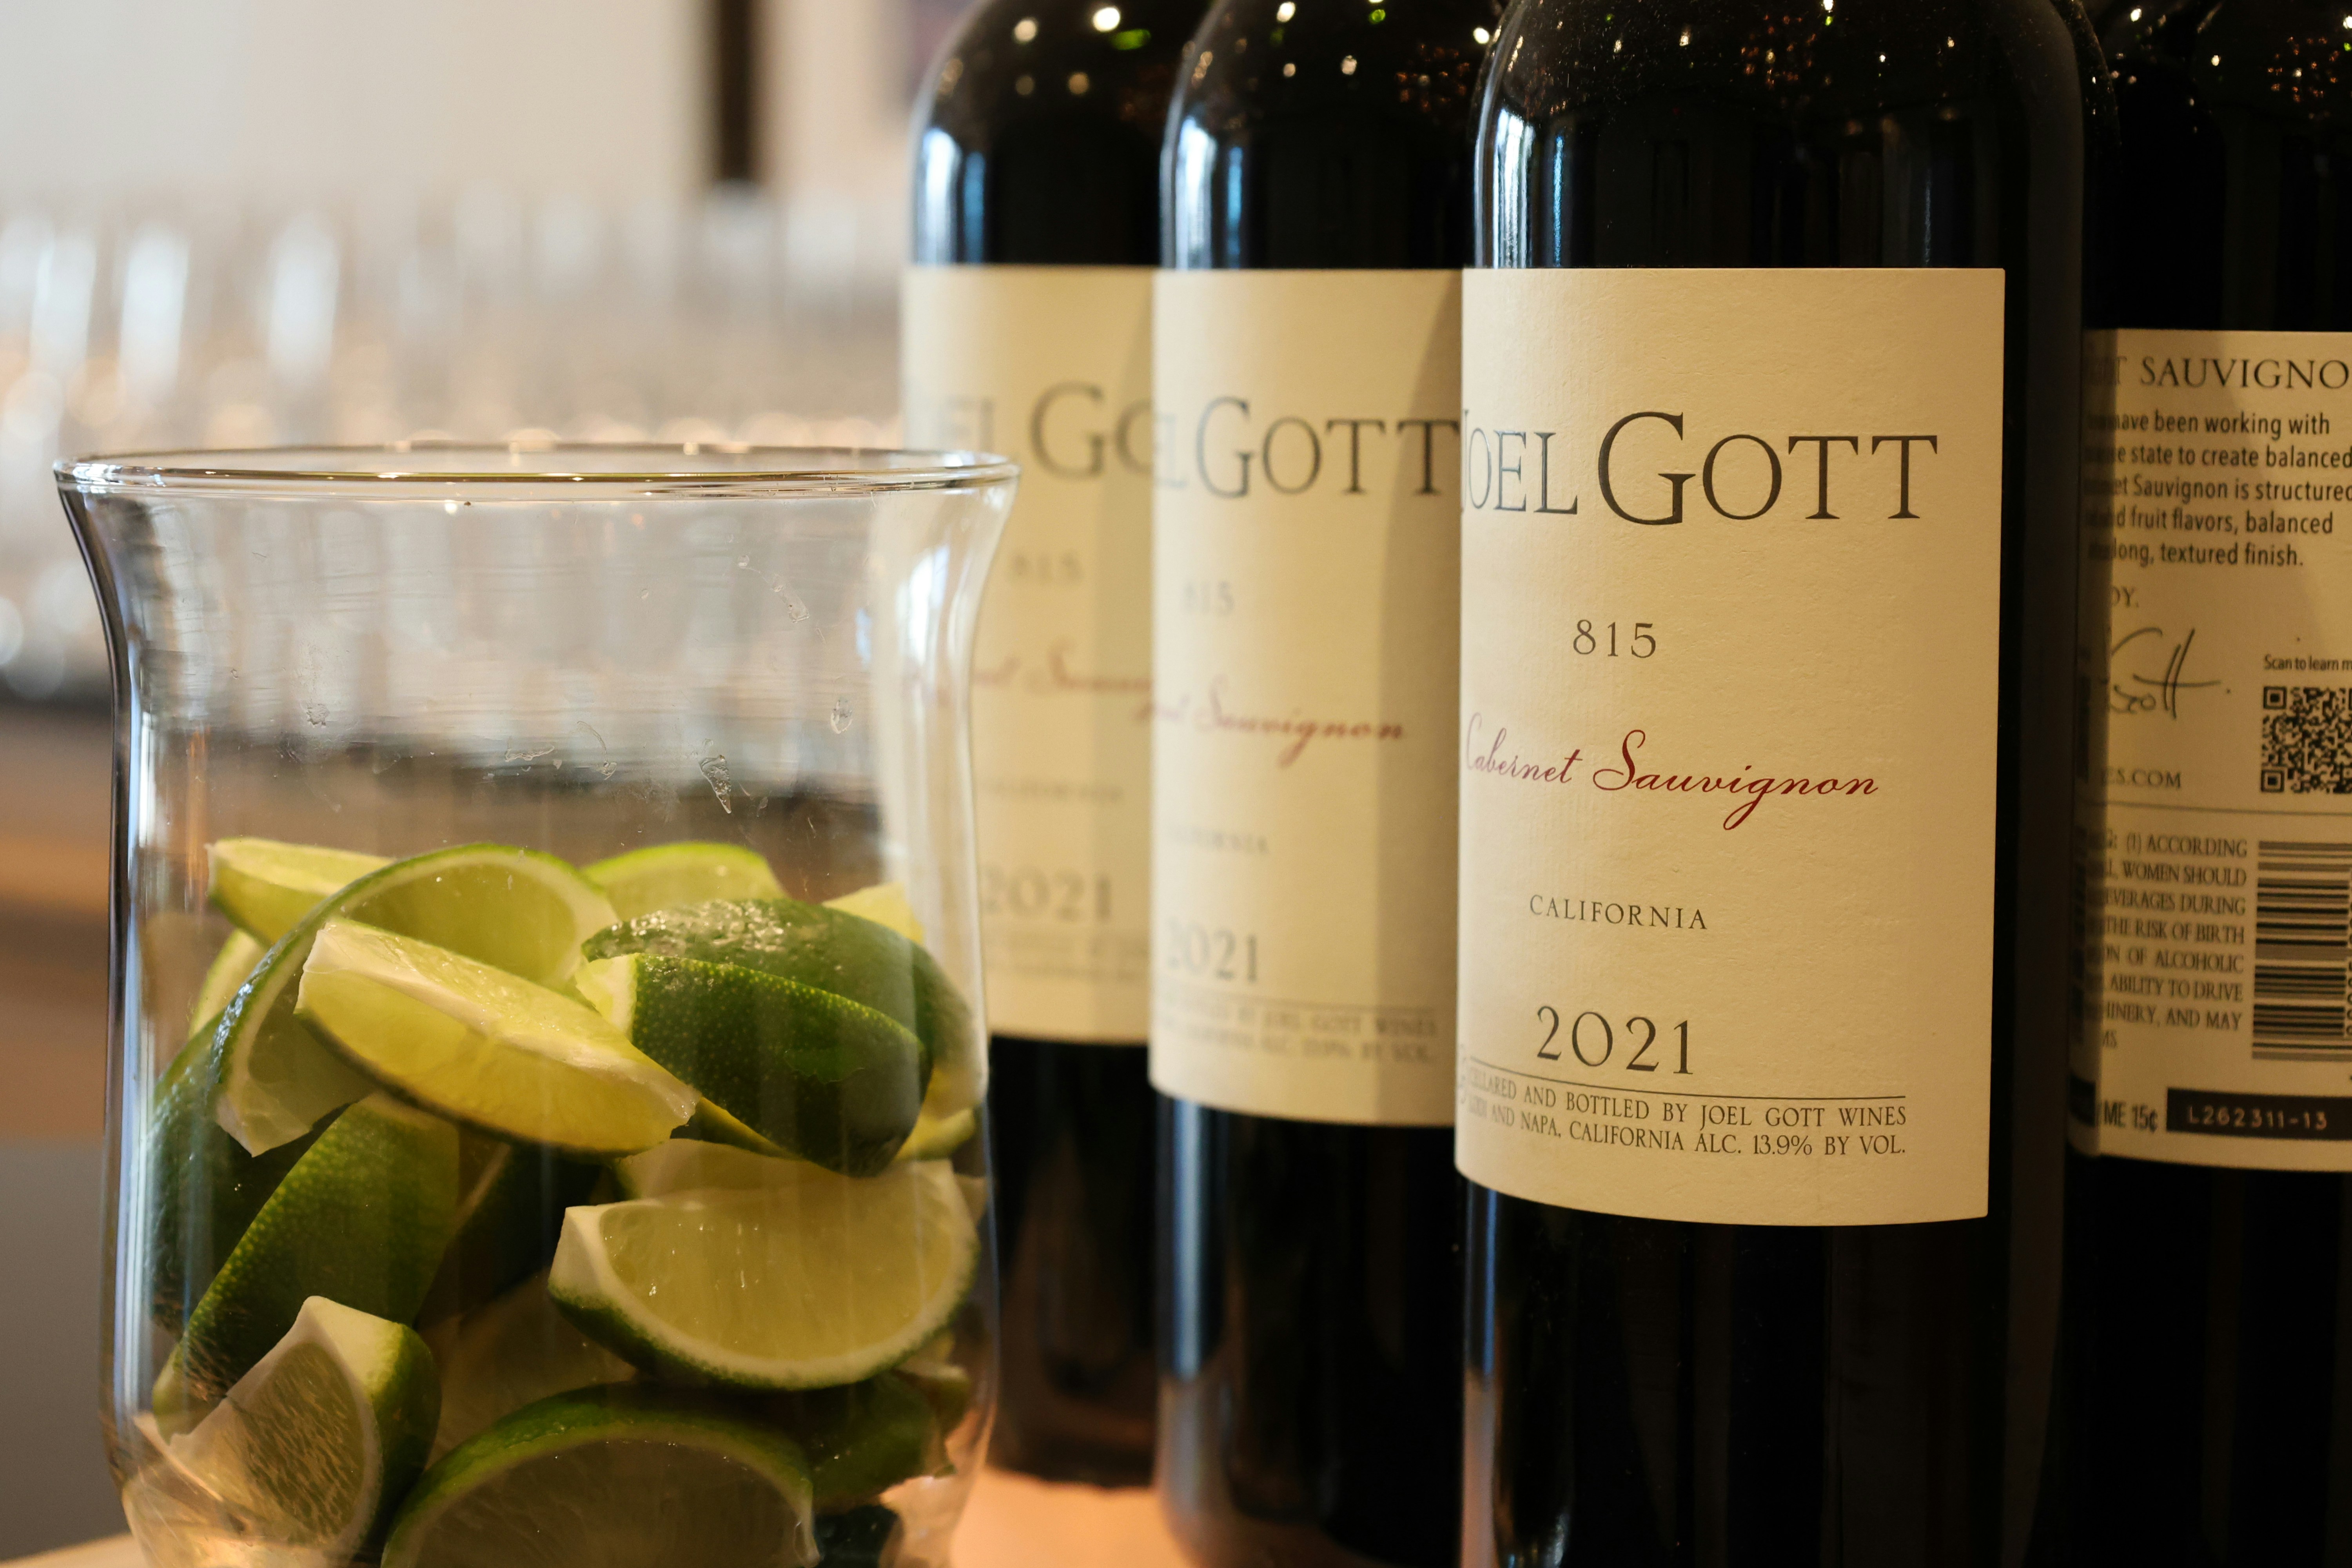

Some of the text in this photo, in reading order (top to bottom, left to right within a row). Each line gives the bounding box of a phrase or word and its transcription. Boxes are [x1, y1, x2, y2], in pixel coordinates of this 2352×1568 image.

[2155, 409, 2198, 432] been
[2205, 411, 2281, 441] working
[2288, 412, 2330, 435] with
[1196, 396, 1461, 499] GOTT
[2132, 444, 2173, 465] state
[2178, 446, 2196, 465] to
[2202, 447, 2259, 467] create
[2266, 445, 2352, 468] balanced
[1462, 409, 1938, 525] JOEL GOTT
[2133, 473, 2227, 504] Sauvignon
[2235, 478, 2249, 500] is
[2131, 505, 2167, 529] fruit
[2172, 507, 2238, 535] flavors,
[2246, 510, 2332, 534] balanced
[2160, 542, 2238, 565] textured
[2245, 541, 2303, 566] finish.
[1572, 619, 1657, 659] 815
[2264, 653, 2292, 670] Scan
[2295, 657, 2307, 670] to
[2309, 655, 2339, 671] learn
[1466, 712, 1879, 830] Cabernet Sauvignon
[2147, 834, 2247, 858] ACCORDING
[2122, 860, 2180, 882] WOMEN
[2183, 865, 2247, 887] SHOULD
[1530, 893, 1708, 930] CALIFORNIA
[2180, 893, 2246, 916] DURING
[2135, 917, 2168, 940] RISK
[2172, 922, 2192, 941] OF
[2196, 923, 2245, 945] BIRTH
[2155, 949, 2244, 973] ALCOHOLIC
[2168, 978, 2191, 998] TO
[2194, 981, 2243, 1002] DRIVE
[2166, 1007, 2201, 1029] AND
[2206, 1010, 2243, 1031] MAY
[1536, 1005, 1694, 1075] 2021
[1524, 1086, 1557, 1108] AND
[1566, 1092, 1650, 1119] BOTTLED
[1663, 1102, 1688, 1122] BY
[1700, 1105, 1752, 1131] JOEL
[1765, 1107, 1825, 1127] GOTT
[1838, 1106, 1906, 1127] WINES
[1521, 1111, 1561, 1138] NAPA,
[1570, 1121, 1684, 1151] CALIFORNIA
[1694, 1133, 1742, 1154] ALC.
[1753, 1134, 1812, 1156] 13.9%
[1824, 1136, 1850, 1155] BY
[1859, 1135, 1906, 1155] VOL.
